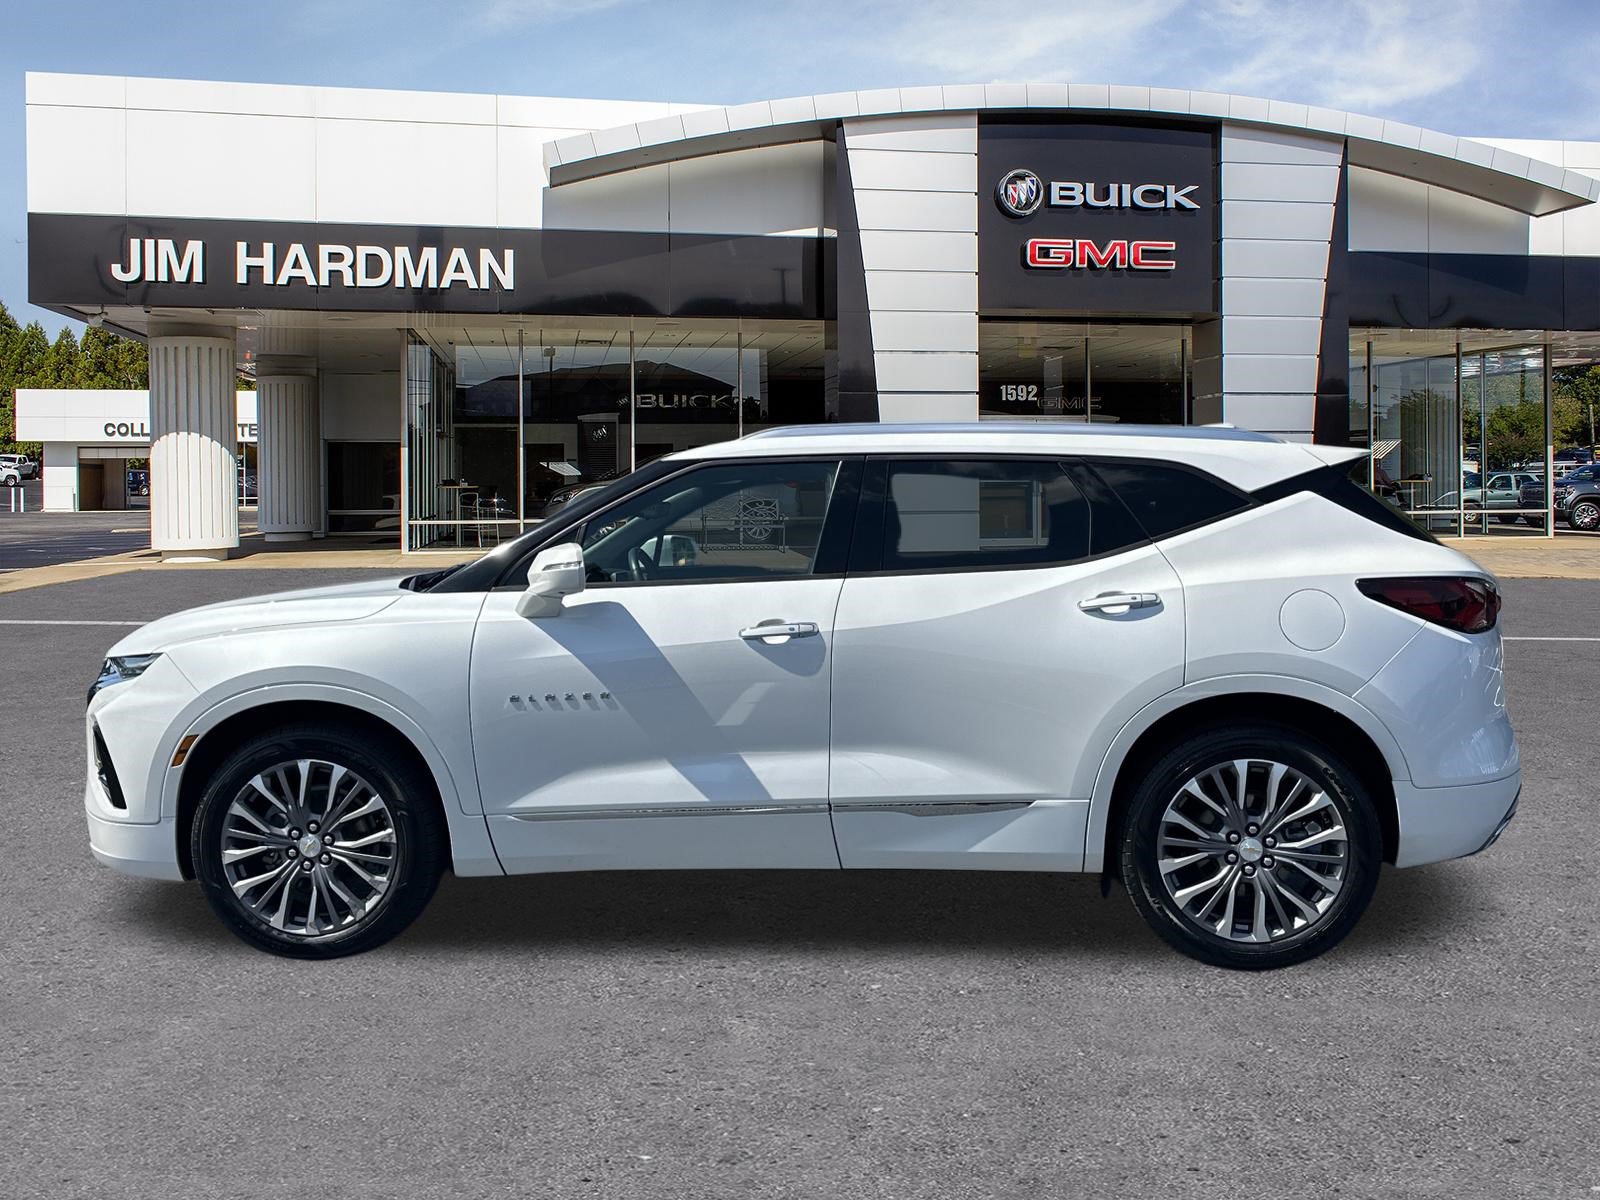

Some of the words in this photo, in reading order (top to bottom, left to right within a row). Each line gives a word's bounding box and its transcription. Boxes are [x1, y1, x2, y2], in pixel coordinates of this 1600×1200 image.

[1050, 181, 1200, 209] BUICK
[1025, 238, 1176, 270] GMC
[111, 238, 204, 283] JIM
[235, 241, 515, 290] HARDMAN
[636, 394, 731, 408] BUICK
[1000, 385, 1038, 401] 1592
[1037, 397, 1103, 409] GMC
[103, 422, 150, 437] COLL
